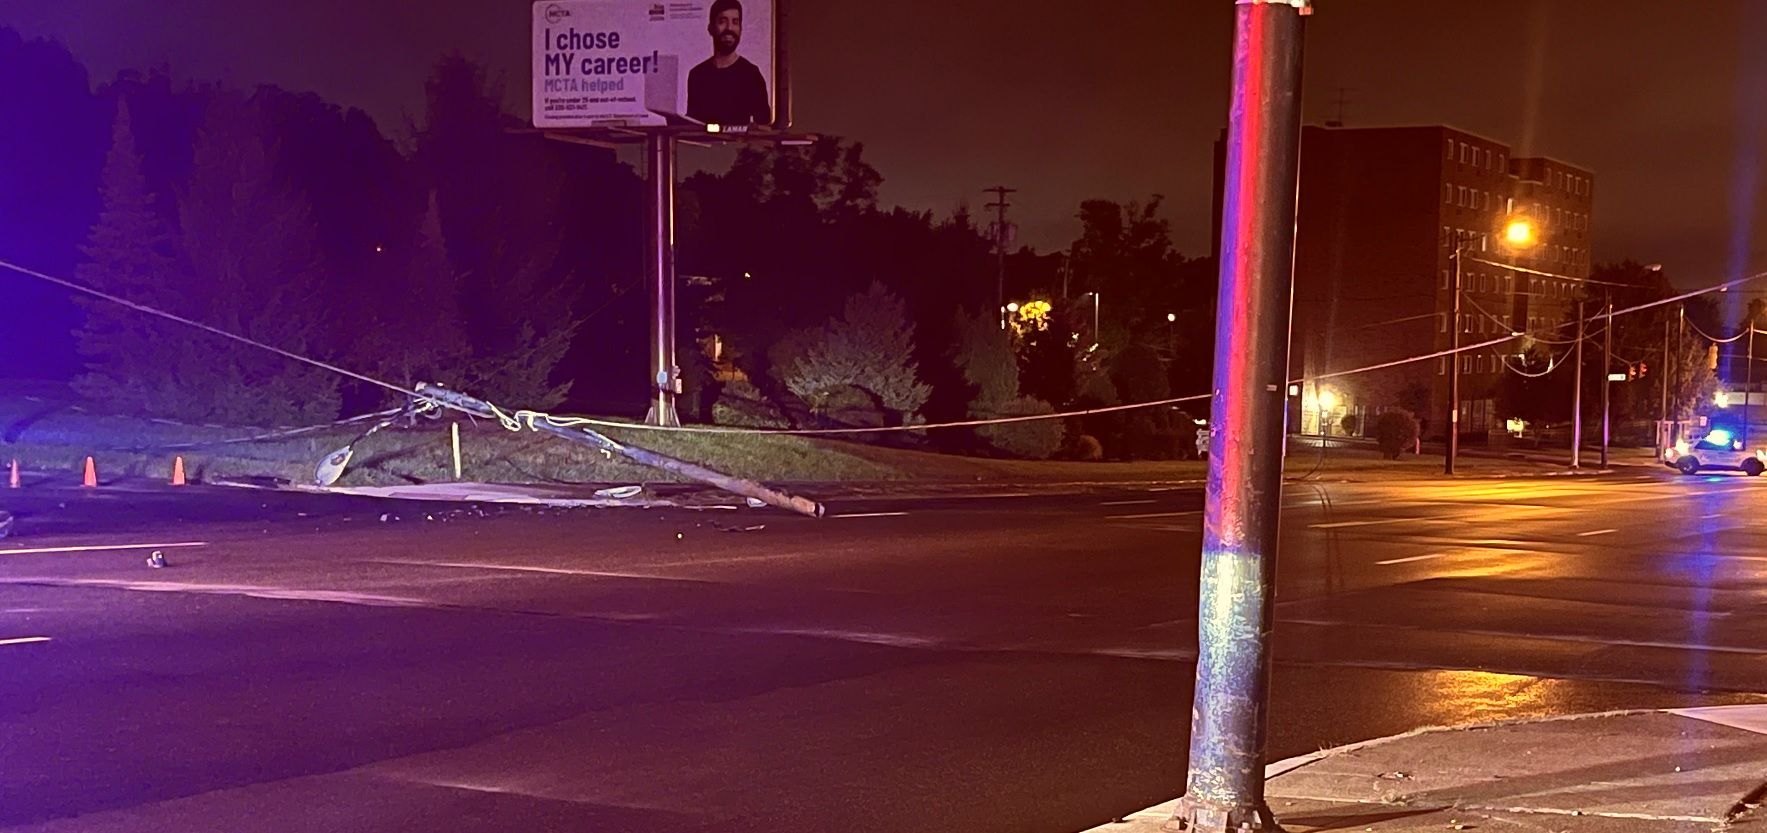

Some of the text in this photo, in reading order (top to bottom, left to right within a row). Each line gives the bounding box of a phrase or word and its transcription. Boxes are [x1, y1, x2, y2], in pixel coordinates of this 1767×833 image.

[545, 27, 620, 51] I chose
[545, 50, 658, 76] MY career!
[544, 77, 624, 95] MCTA helped
